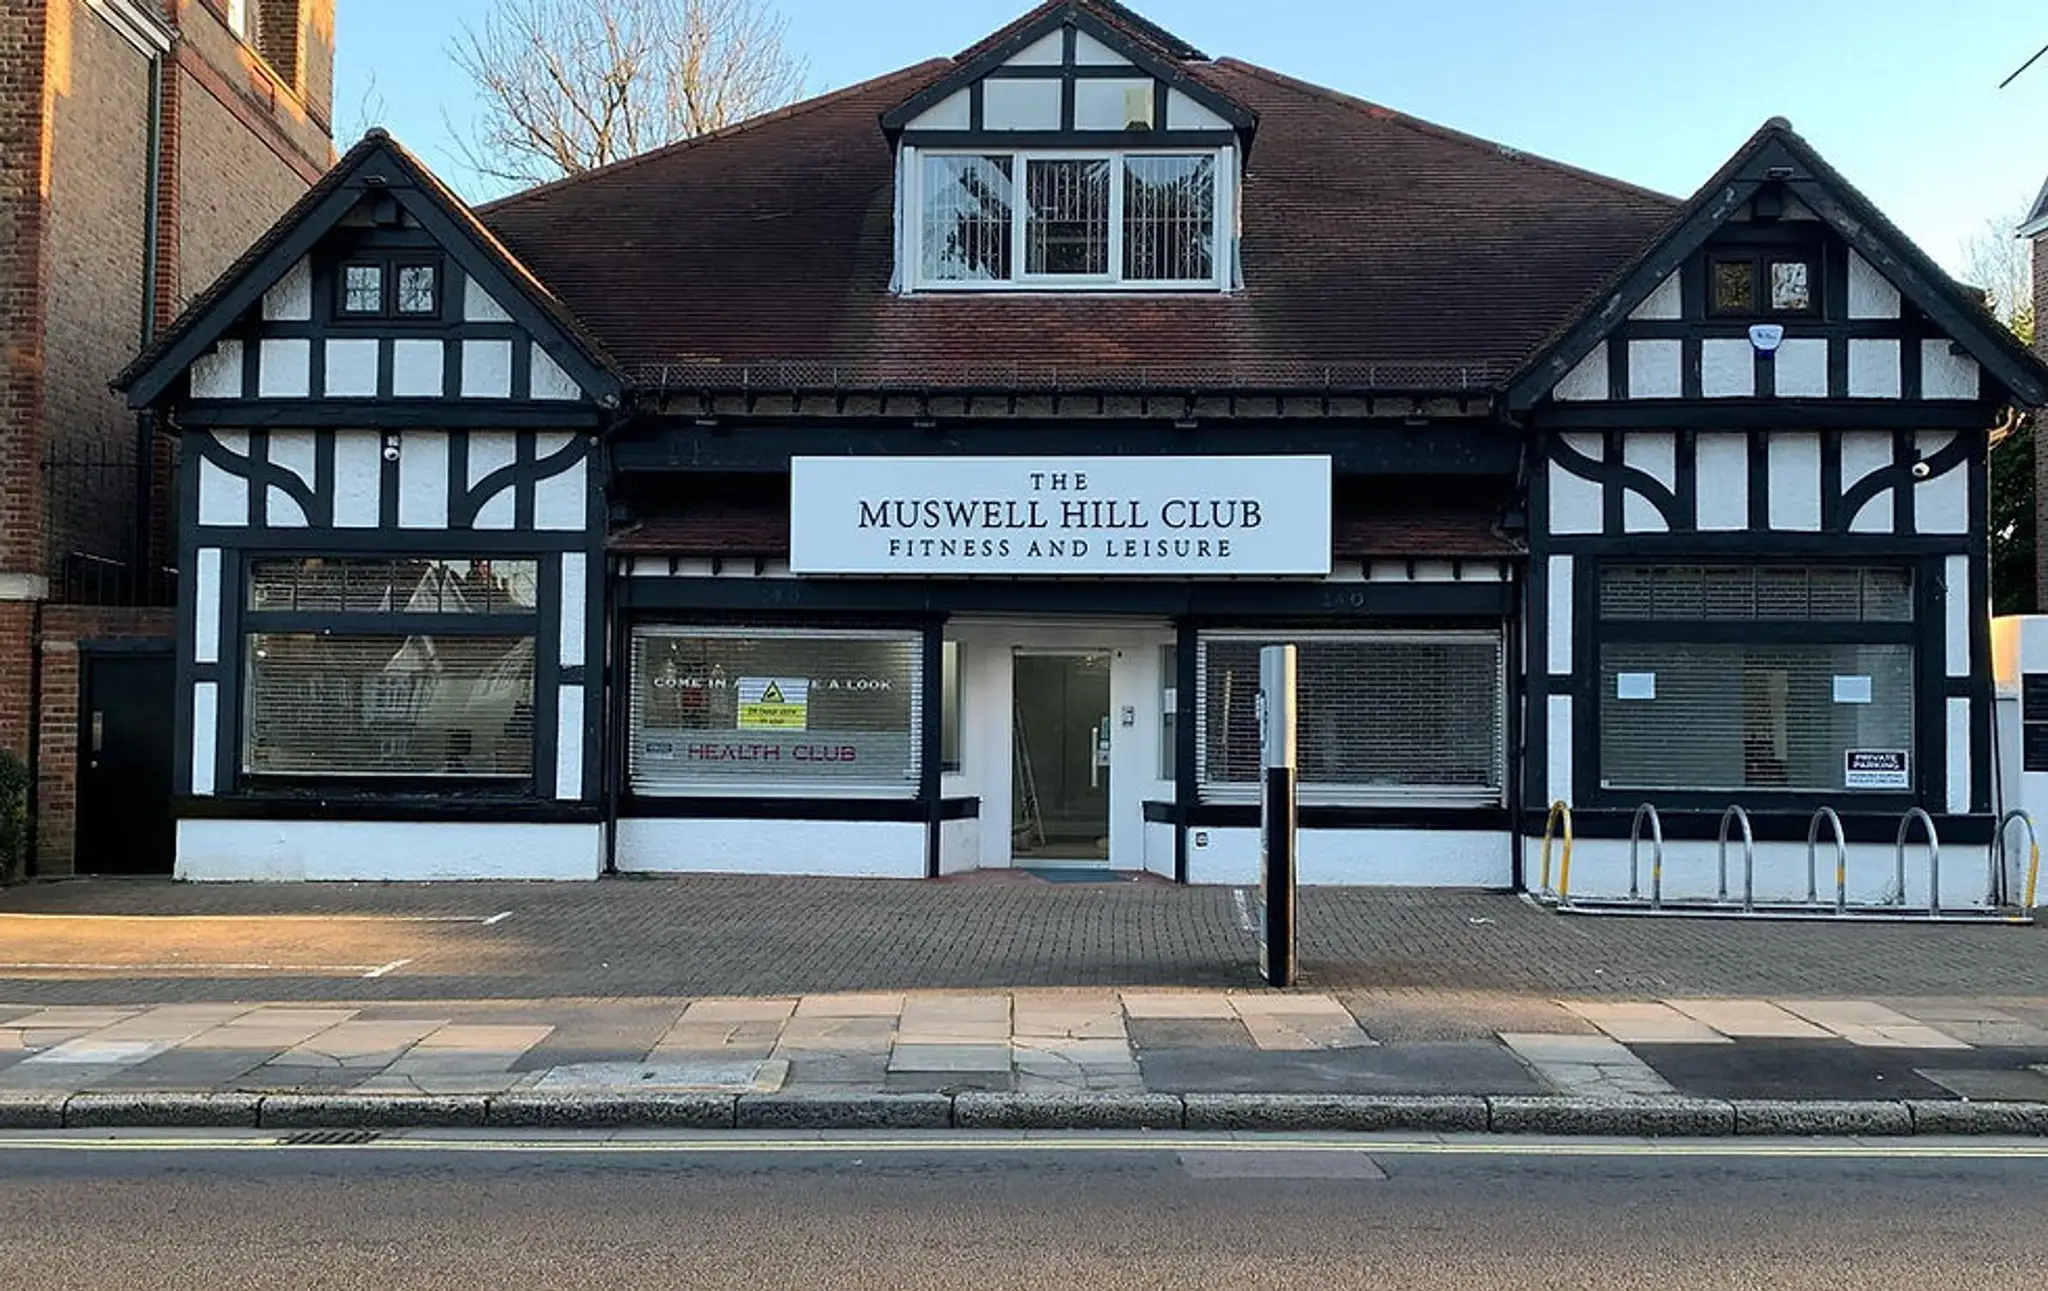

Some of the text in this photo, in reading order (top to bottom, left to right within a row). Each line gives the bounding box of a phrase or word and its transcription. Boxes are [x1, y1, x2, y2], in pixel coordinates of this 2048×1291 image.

[1030, 472, 1088, 490] THE
[858, 499, 1262, 528] MUSWELL HILL CLUB
[889, 539, 1231, 557] FITNESS AND LEISURE
[654, 679, 704, 689] COME
[708, 679, 727, 689] IN
[829, 679, 840, 690] A
[847, 679, 893, 691] LOOK
[688, 743, 781, 760] HEALTH
[792, 744, 856, 761] CLUB
[1852, 761, 1900, 769] PARKING
